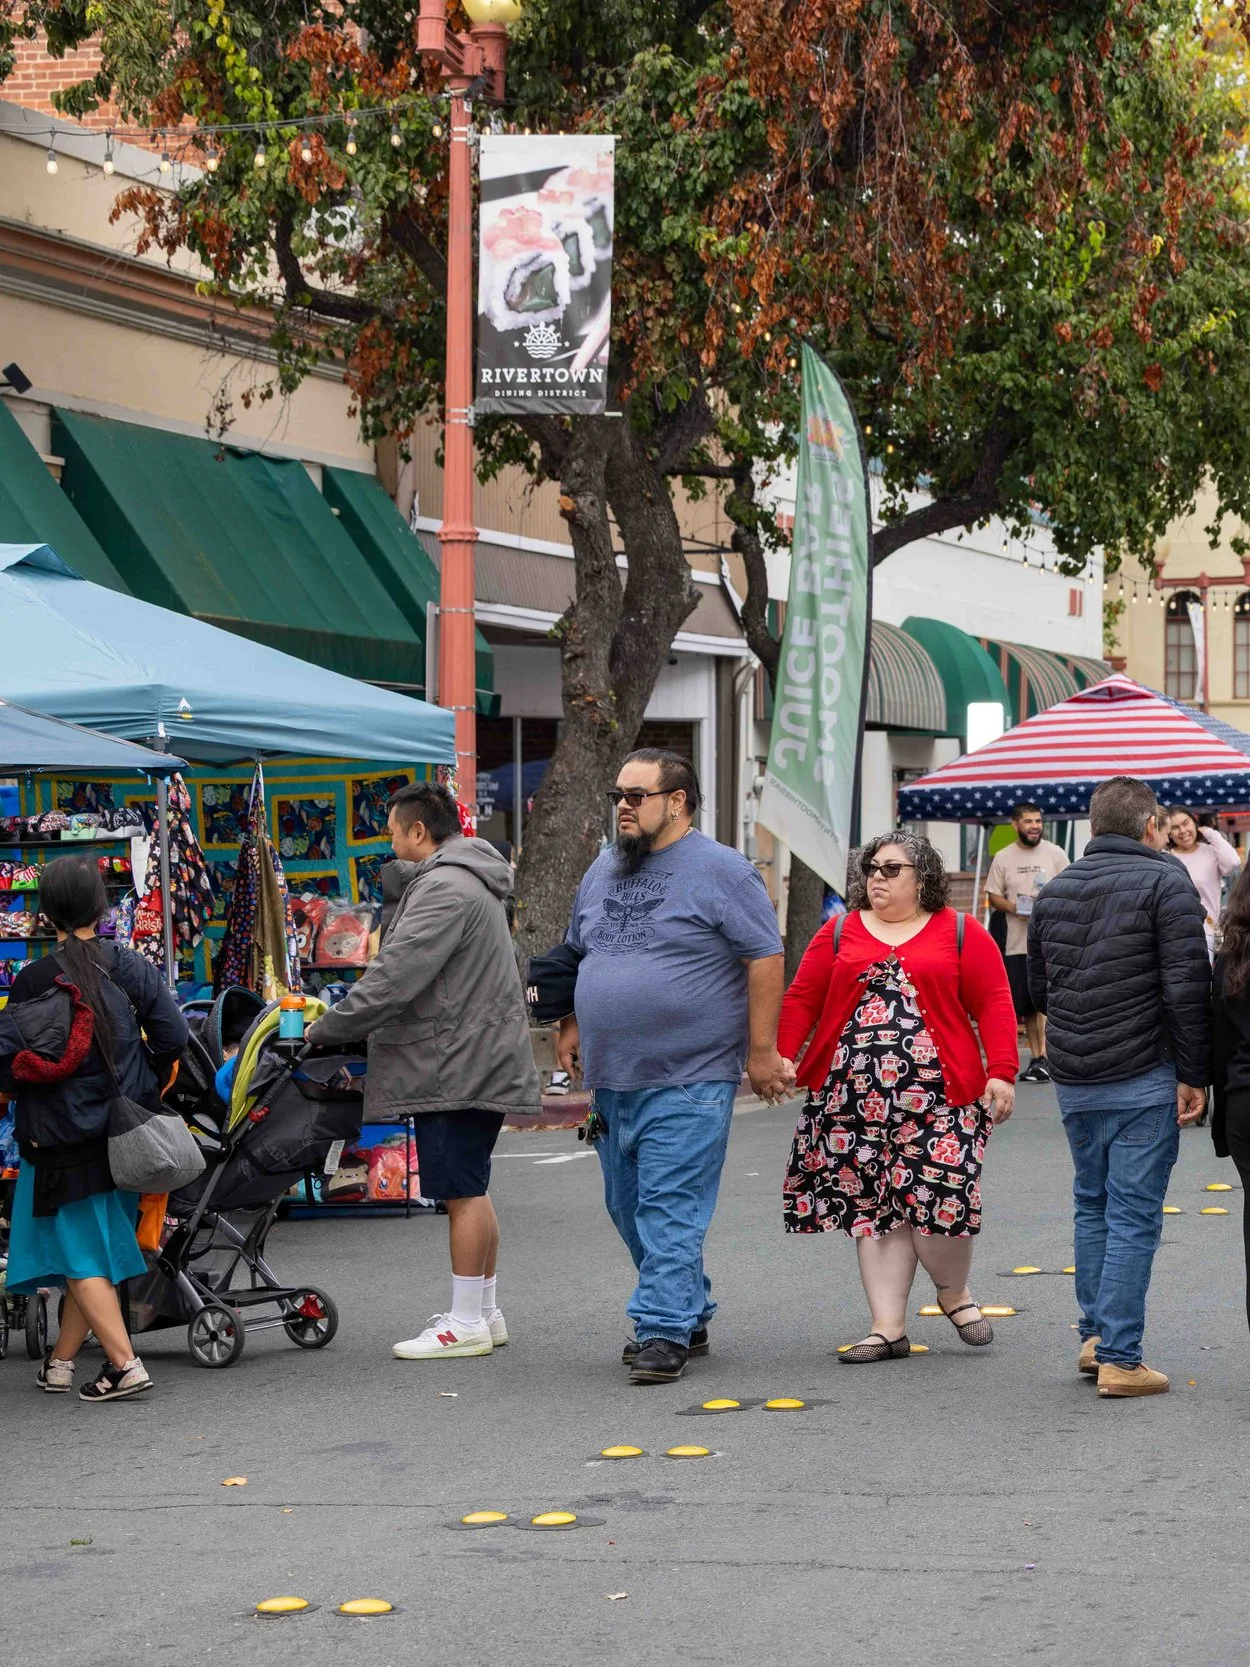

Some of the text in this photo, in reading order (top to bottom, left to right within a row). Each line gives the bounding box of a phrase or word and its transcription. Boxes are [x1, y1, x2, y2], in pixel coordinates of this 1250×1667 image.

[481, 368, 604, 383] RIVERTOWN
[537, 389, 587, 397] DISTRICT
[616, 878, 662, 893] BUFFALO
[597, 930, 647, 943] BODY LOTION
[436, 1330, 458, 1347] N
